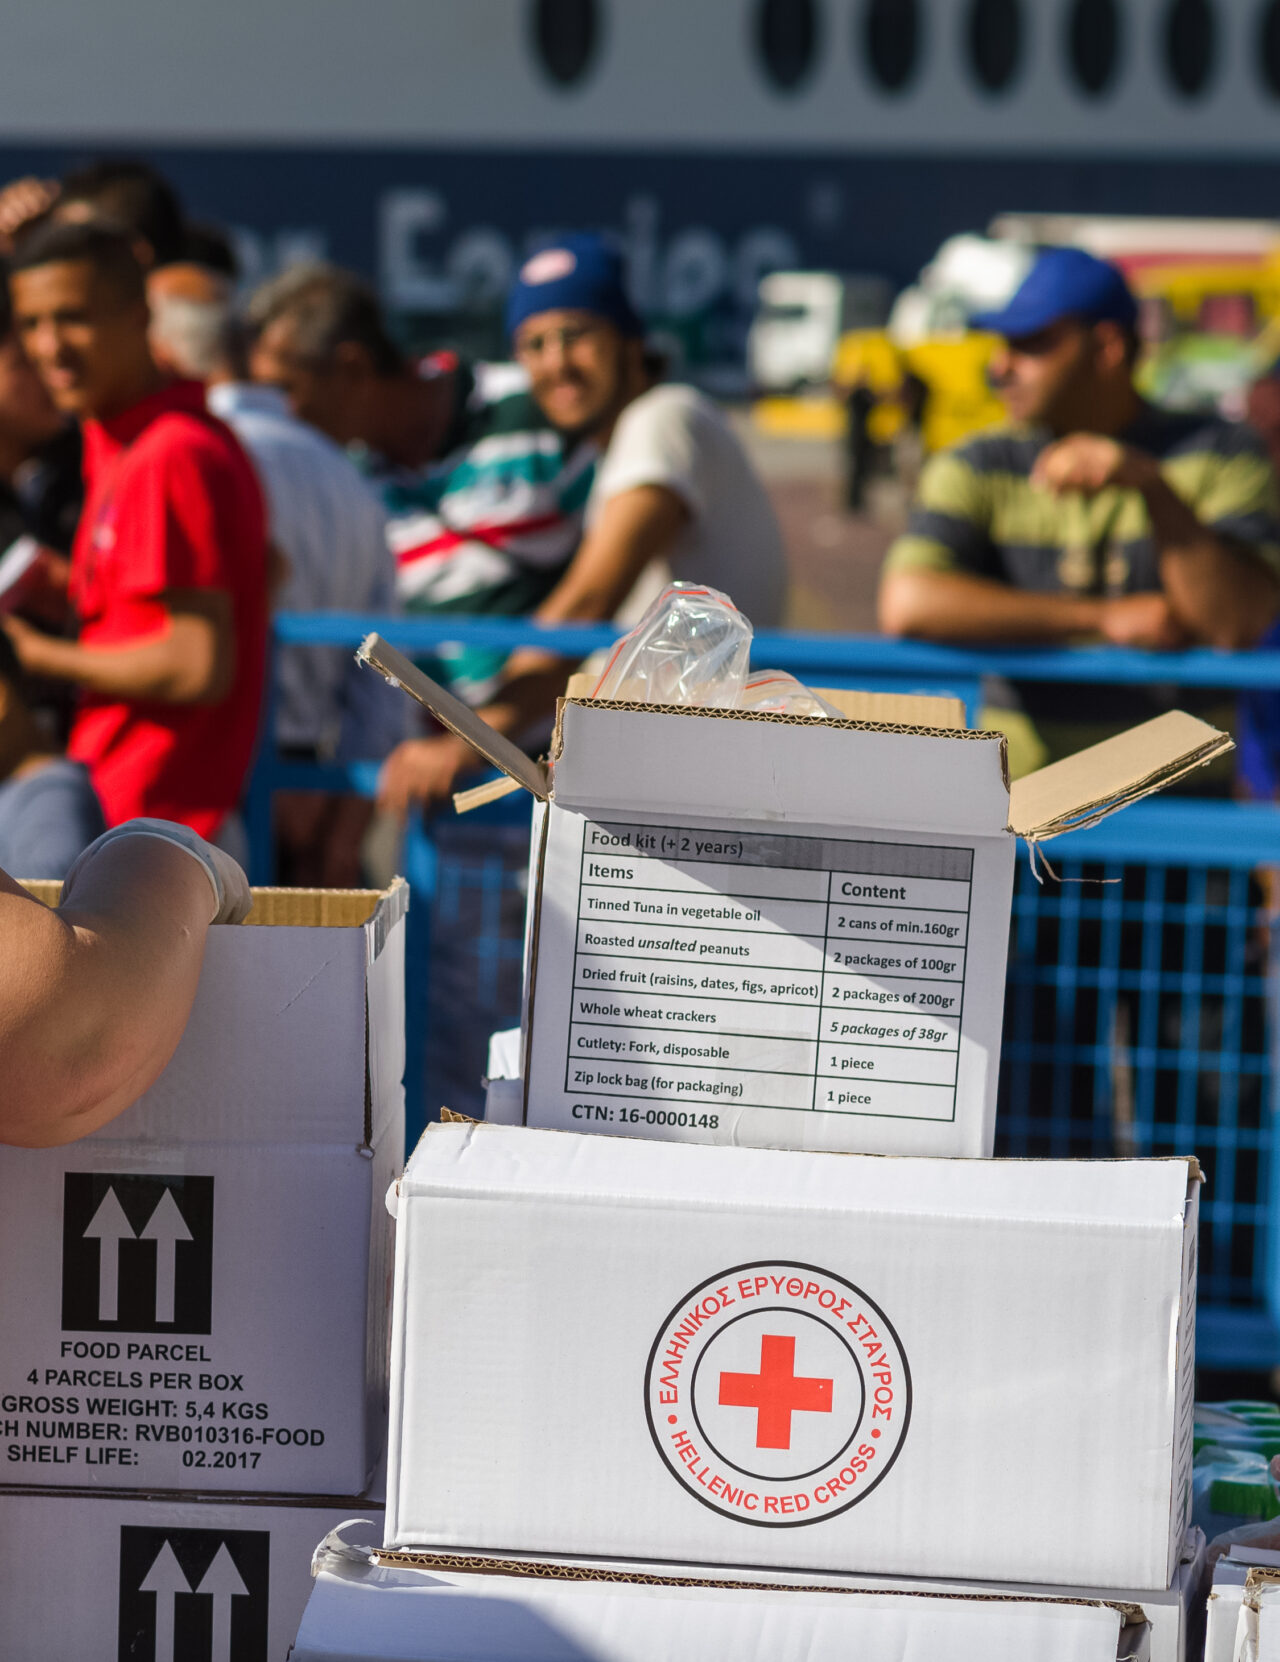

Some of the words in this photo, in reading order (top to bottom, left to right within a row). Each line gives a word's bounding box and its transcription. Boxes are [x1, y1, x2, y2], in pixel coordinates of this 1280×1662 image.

[591, 831, 631, 848] Food
[635, 834, 656, 849] kit
[661, 836, 676, 852] (+
[680, 838, 691, 851] 2
[695, 841, 743, 858] years)
[589, 864, 634, 880] Items
[841, 882, 907, 900] Content
[588, 898, 630, 913] Tinned
[633, 901, 663, 915] Tuna
[666, 903, 678, 916] in
[681, 905, 742, 921] vegetable
[745, 910, 761, 922] oil
[838, 916, 846, 928] 2
[849, 919, 877, 931] cans
[880, 920, 895, 932] of
[896, 922, 960, 938] min.160gr
[585, 933, 635, 948] Roasted
[638, 938, 697, 952] unsalted
[700, 943, 750, 957] peanuts
[833, 952, 842, 963] 2
[844, 954, 902, 970] packages
[904, 957, 918, 969] of
[921, 958, 957, 974] 100gr
[582, 968, 616, 982] Dried
[619, 970, 647, 984] fruit
[650, 972, 698, 989] (raisins,
[700, 977, 739, 992] dates,
[742, 980, 767, 995] figs,
[770, 984, 819, 999] apricot)
[832, 987, 840, 998] 2
[843, 988, 900, 1004] packages
[903, 992, 917, 1004] of
[919, 993, 955, 1008] 200gr
[580, 1002, 621, 1016] Whole
[624, 1005, 663, 1019] wheat
[666, 1009, 717, 1024] crackers
[830, 1021, 838, 1033] 5
[841, 1023, 900, 1039] packages
[902, 1026, 918, 1041] of
[918, 1028, 949, 1043] 38gr
[577, 1037, 626, 1053] Cutlety:
[629, 1040, 660, 1055] Fork,
[663, 1043, 730, 1059] disposable
[830, 1056, 838, 1067] 1
[841, 1057, 875, 1070] piece
[574, 1071, 594, 1086] Zip
[597, 1072, 622, 1086] lock
[625, 1075, 648, 1090] bag
[651, 1077, 674, 1091] (for
[677, 1080, 744, 1097] packaging)
[827, 1090, 835, 1102] 1
[838, 1091, 872, 1105] piece
[571, 1104, 614, 1121] CTN:
[619, 1108, 719, 1129] 16-0000148
[60, 1340, 121, 1360] FOOD
[127, 1343, 212, 1363] PARCEL
[659, 1286, 736, 1405] ΕΛΛΗΝΙΚΟΣ
[737, 1275, 853, 1320] ΕΡΥΘΡΟΣ
[846, 1313, 894, 1421] ΣΤΑΥΡΟΣ
[27, 1368, 39, 1386] 4
[45, 1369, 143, 1390] PARCELS
[150, 1372, 193, 1391] PER
[199, 1373, 244, 1392] BOX
[1, 1395, 79, 1417] GROSS
[86, 1397, 178, 1418] WEIGHT:
[185, 1400, 215, 1422] 5,4
[222, 1402, 269, 1421] KGS
[26, 1420, 128, 1441] NUMBER:
[135, 1423, 325, 1448] RVB010316-FOOD
[7, 1444, 78, 1465] SHELF
[85, 1446, 139, 1466] LIFE:
[182, 1449, 261, 1470] 02.2017
[671, 1430, 760, 1511] HELLENIC
[764, 1494, 810, 1514] RED
[813, 1444, 876, 1504] CROSS
